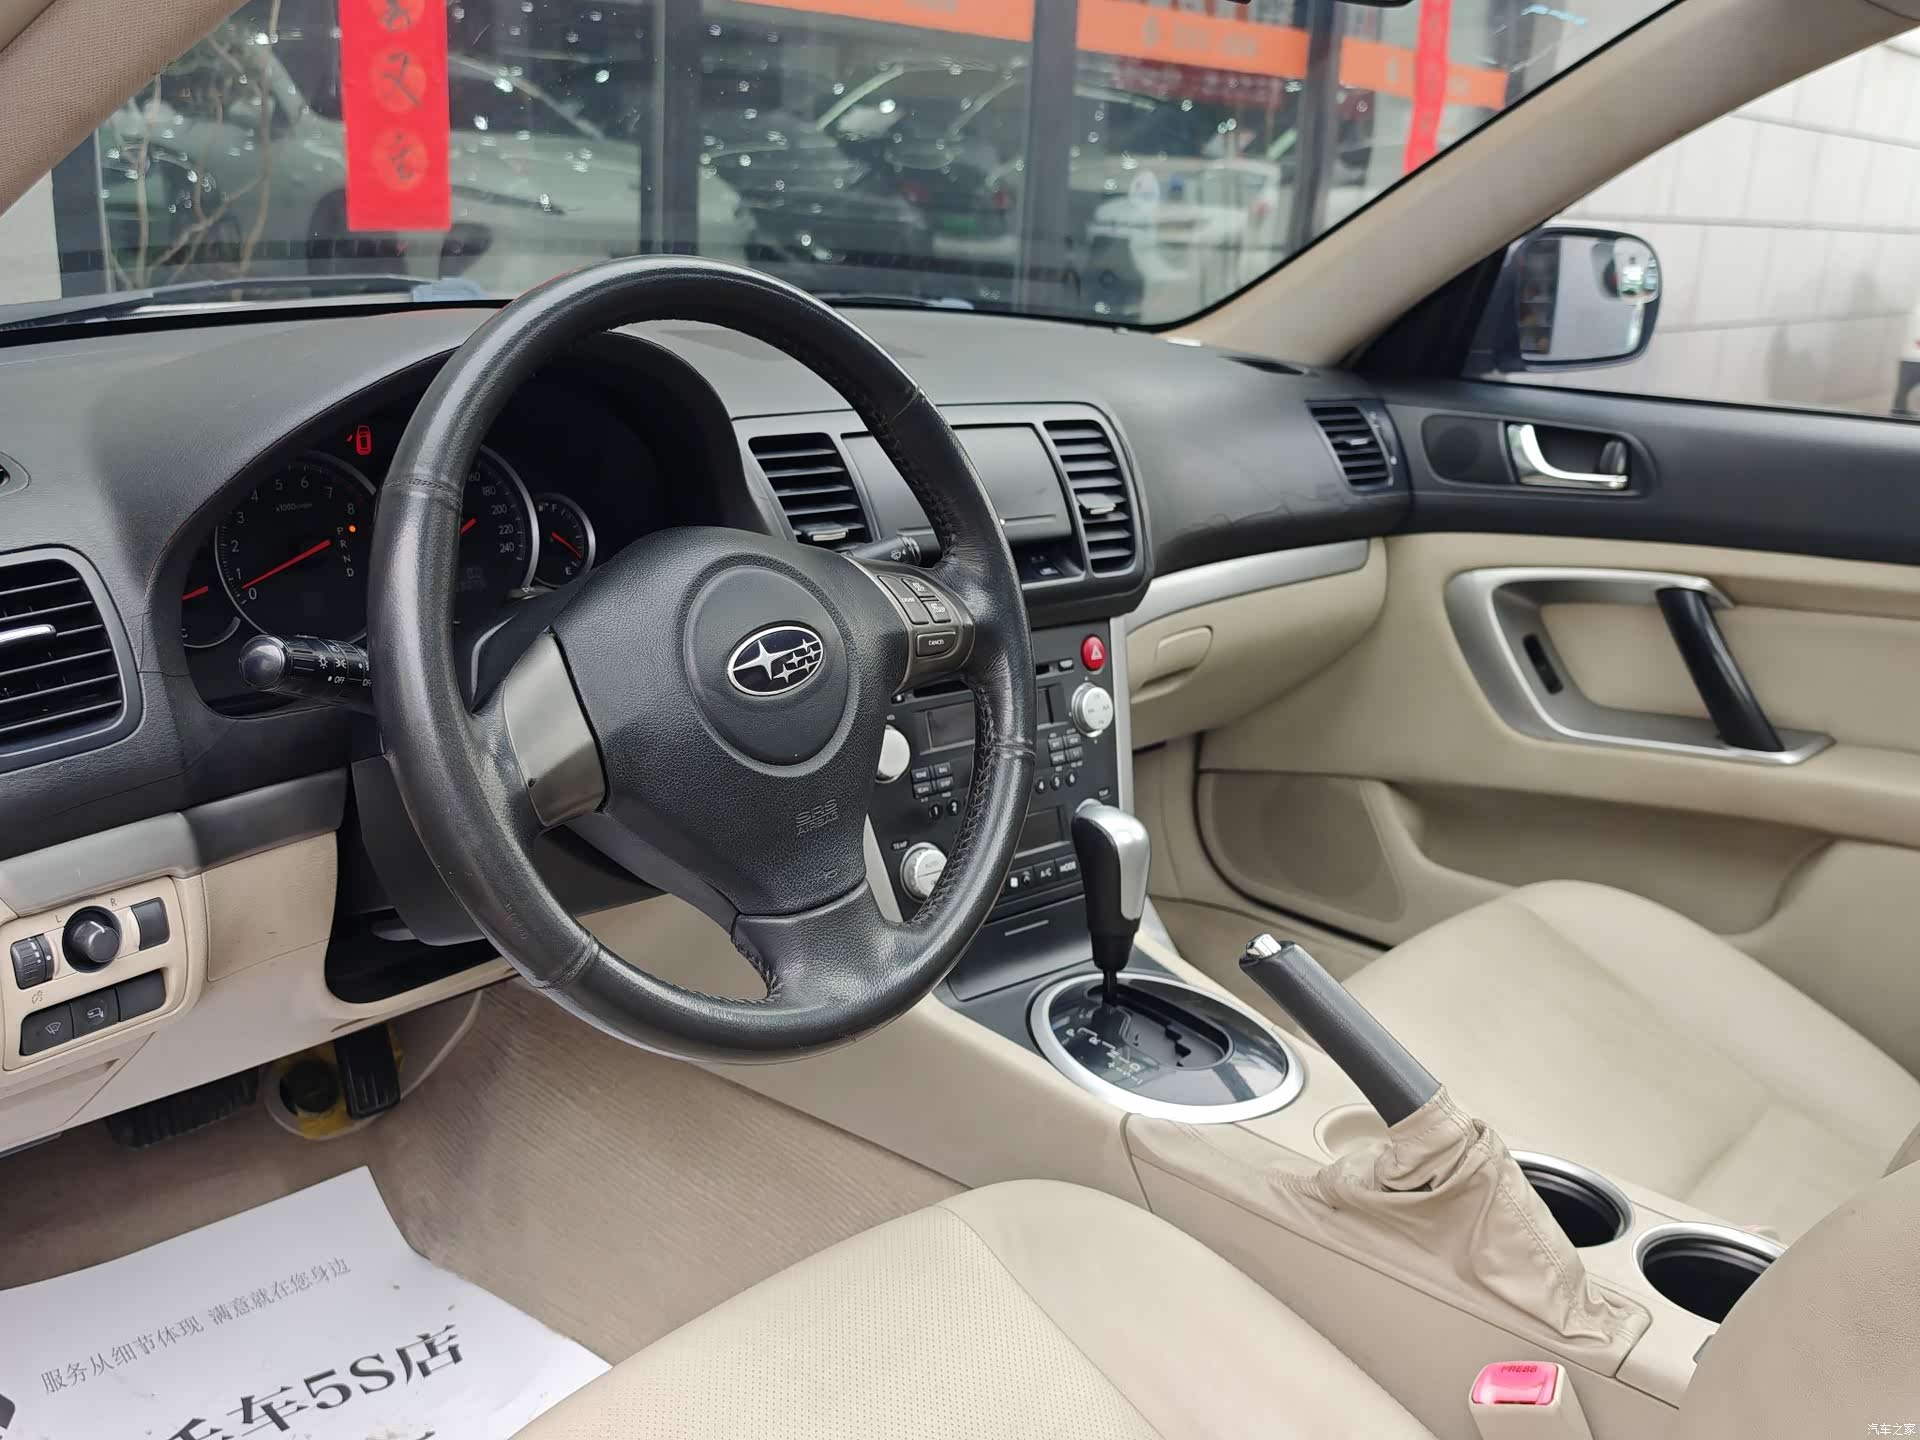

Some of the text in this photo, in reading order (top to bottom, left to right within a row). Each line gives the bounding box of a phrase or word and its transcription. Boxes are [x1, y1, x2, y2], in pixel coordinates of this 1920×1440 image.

[275, 480, 283, 490] 5
[300, 476, 309, 488] 6
[251, 489, 259, 501] 4
[482, 487, 496, 496] 180
[347, 504, 355, 514] 8
[491, 505, 508, 515] 200
[552, 504, 557, 512] F
[238, 512, 245, 524] 3
[337, 527, 344, 536] P
[499, 524, 514, 534] 220
[231, 540, 240, 552] 2
[340, 540, 348, 549] R
[500, 543, 515, 553] 240
[236, 568, 242, 580] 1
[346, 568, 355, 577] D
[565, 567, 572, 576] E
[249, 588, 258, 600] 0
[334, 676, 346, 685] OFF
[110, 898, 118, 906] R
[55, 914, 62, 923] L
[40, 1256, 352, 1395] 服务从细节体现 满意就在您身边
[1501, 1365, 1538, 1373] PRESS
